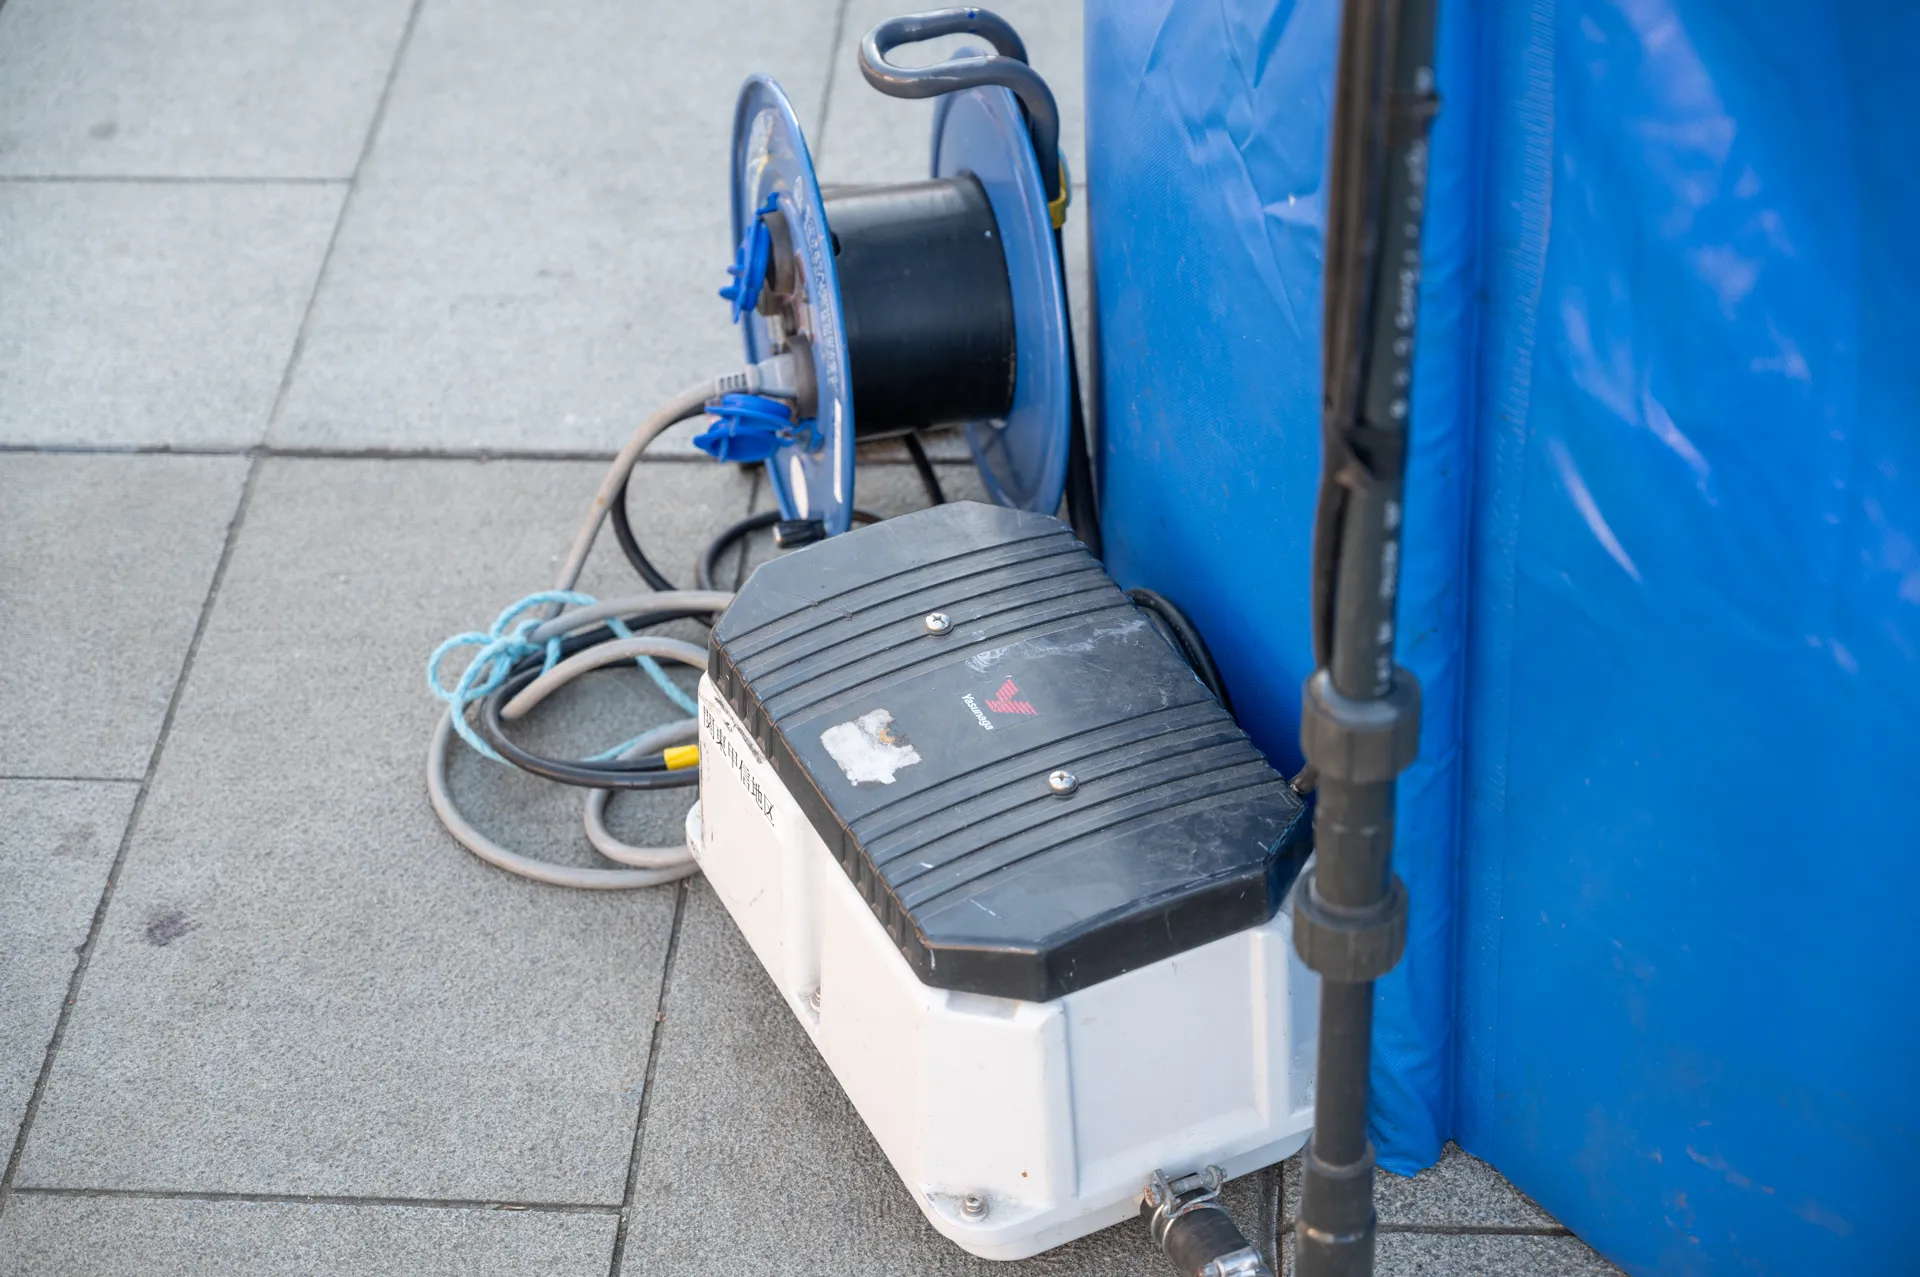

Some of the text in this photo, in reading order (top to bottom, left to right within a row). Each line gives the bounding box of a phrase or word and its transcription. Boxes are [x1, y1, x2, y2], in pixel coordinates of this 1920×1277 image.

[962, 693, 994, 731] Yasunaga
[703, 705, 775, 827] 関東甲信地区
